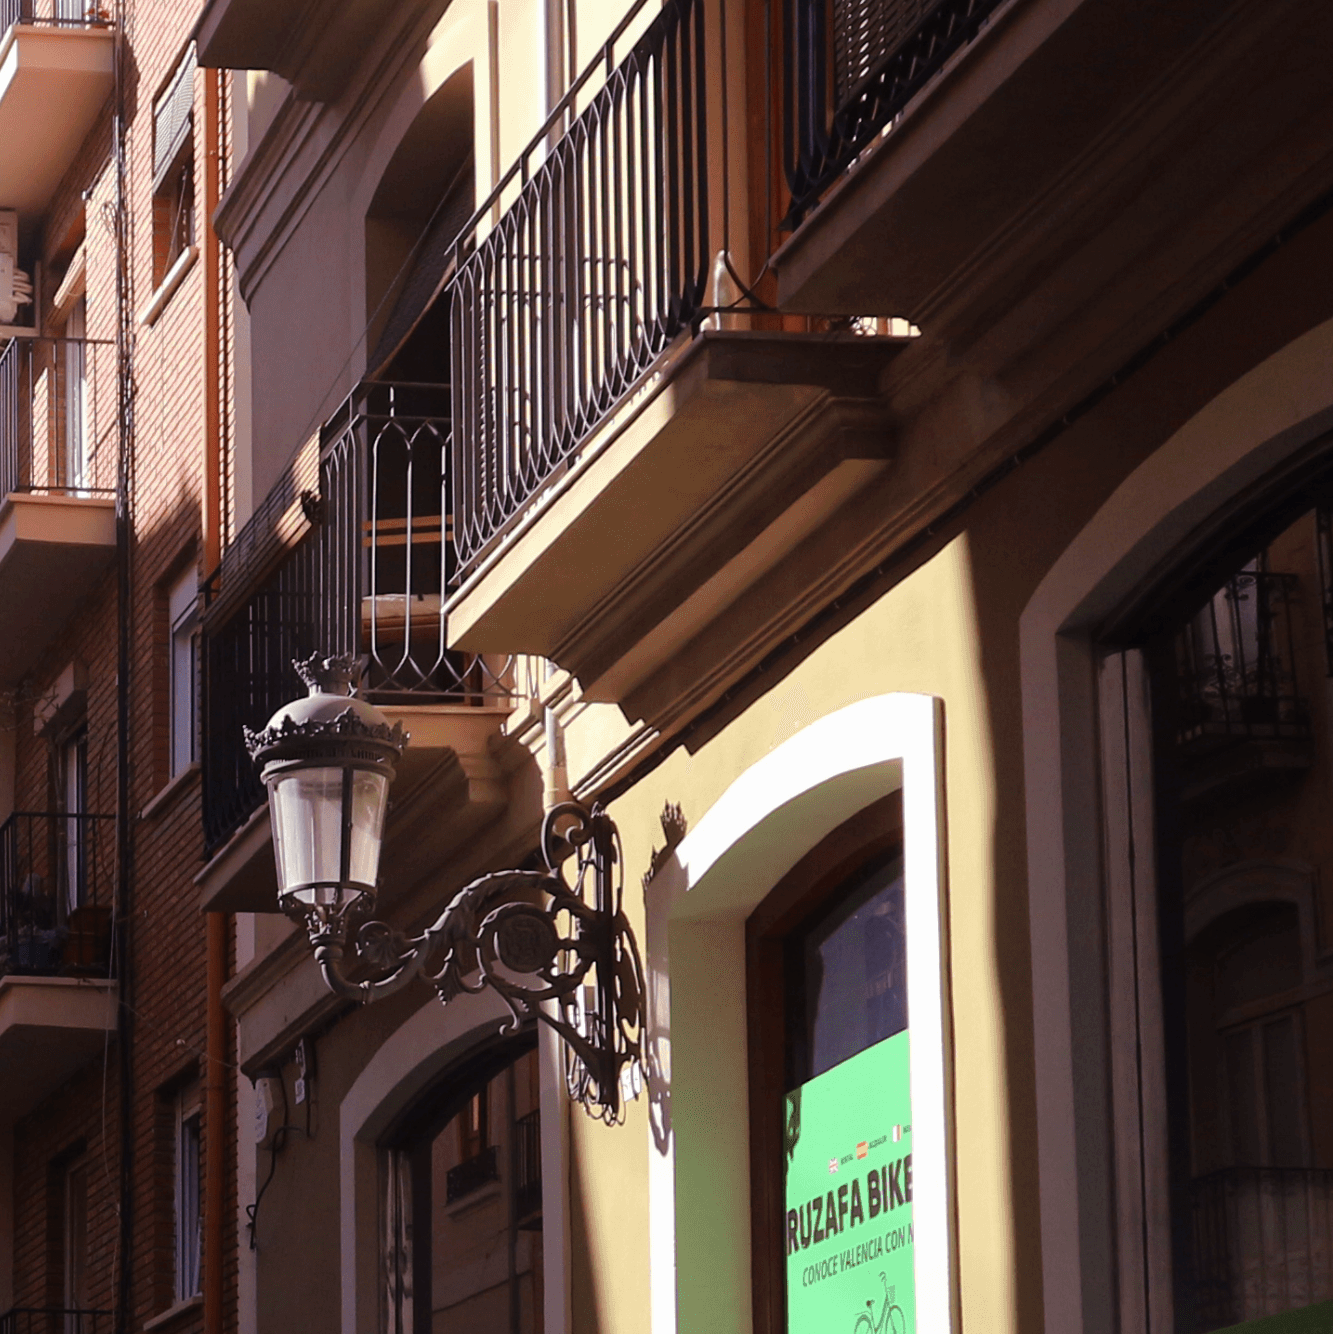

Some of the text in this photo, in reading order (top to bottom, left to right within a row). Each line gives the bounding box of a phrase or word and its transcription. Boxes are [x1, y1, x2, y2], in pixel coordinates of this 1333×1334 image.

[787, 1153, 913, 1256] RUZAFA BIKE
[802, 1254, 838, 1287] CONOCE
[839, 1236, 882, 1272] VALENCIA
[885, 1226, 905, 1254] CON
